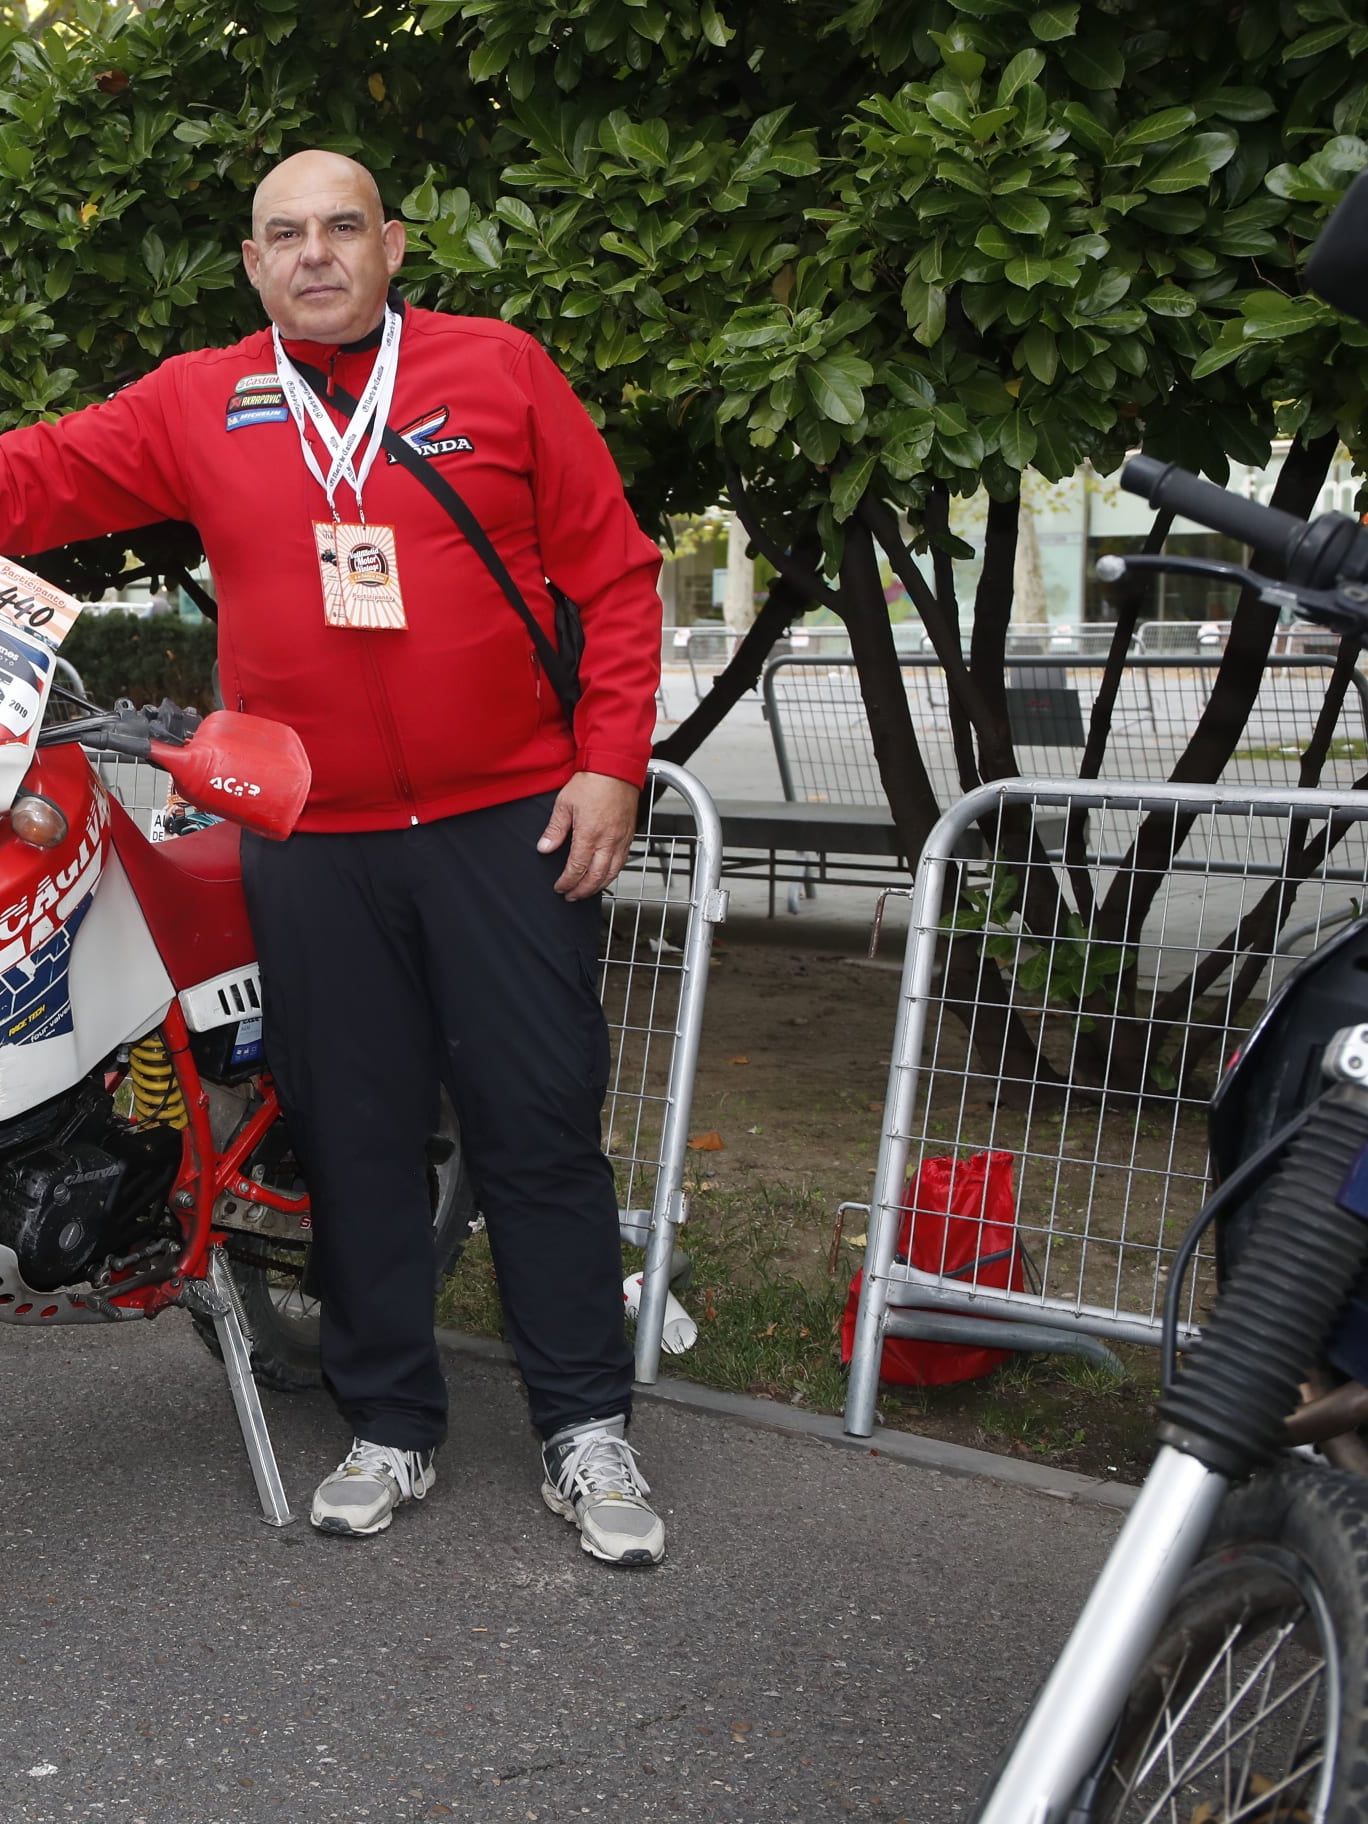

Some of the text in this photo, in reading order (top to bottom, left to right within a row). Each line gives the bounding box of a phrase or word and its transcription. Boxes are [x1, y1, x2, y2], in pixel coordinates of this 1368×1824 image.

[388, 438, 472, 464] NDA
[0, 565, 67, 610] Participante
[8, 698, 29, 719] 2019
[8, 1017, 28, 1037] RACE
[28, 1004, 46, 1023] TECH
[30, 1025, 49, 1043] four
